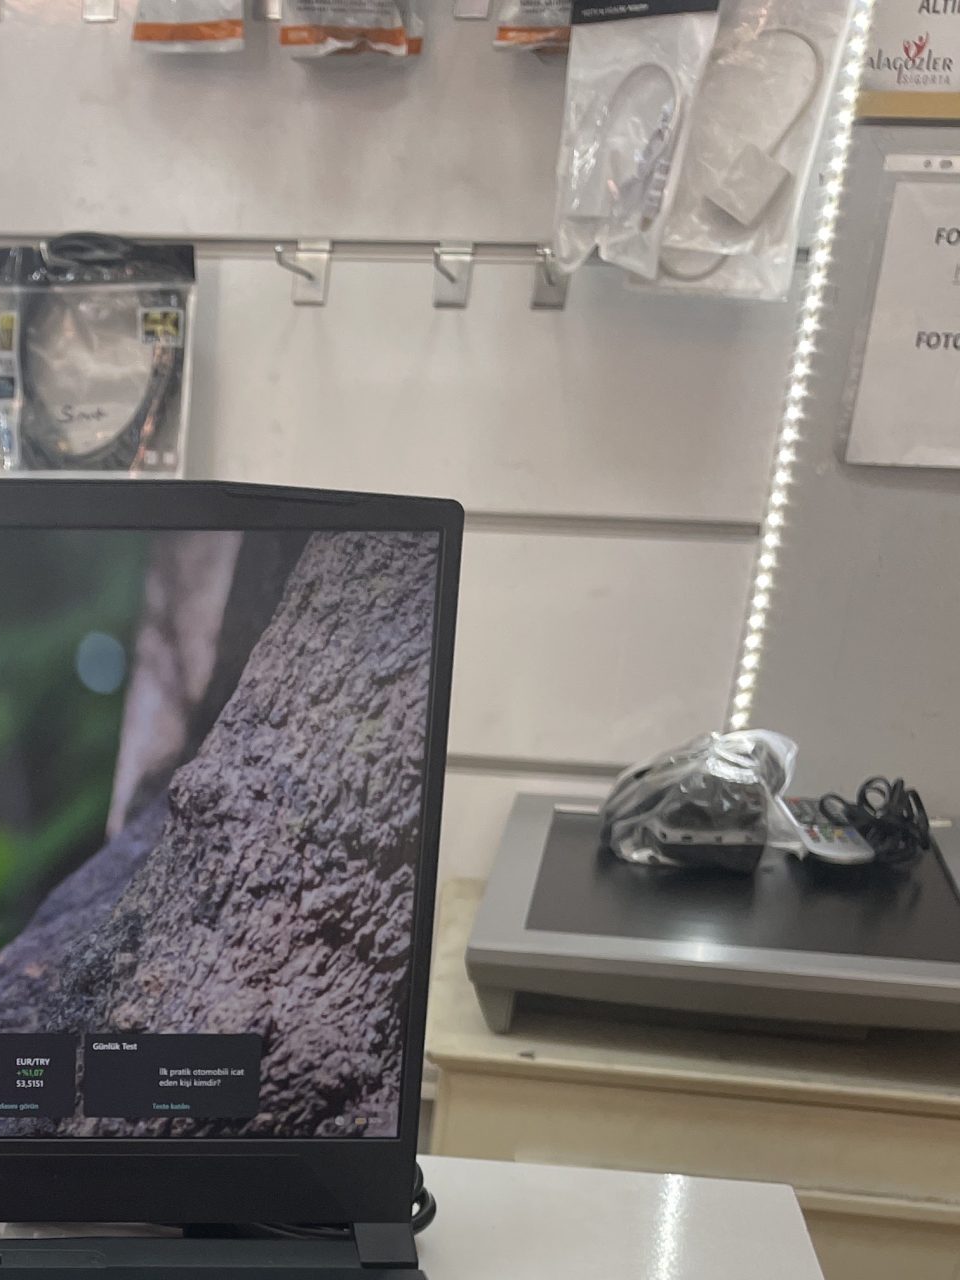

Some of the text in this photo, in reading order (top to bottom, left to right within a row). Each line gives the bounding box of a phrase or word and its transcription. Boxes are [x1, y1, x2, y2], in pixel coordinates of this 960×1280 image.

[93, 1042, 138, 1050] Günlük Test
[16, 1058, 50, 1067] EUR/TRY
[170, 1068, 244, 1077] pratik otomobili icat
[16, 1080, 44, 1088] 53,5151
[159, 1079, 221, 1088] eden kişi kimdir?
